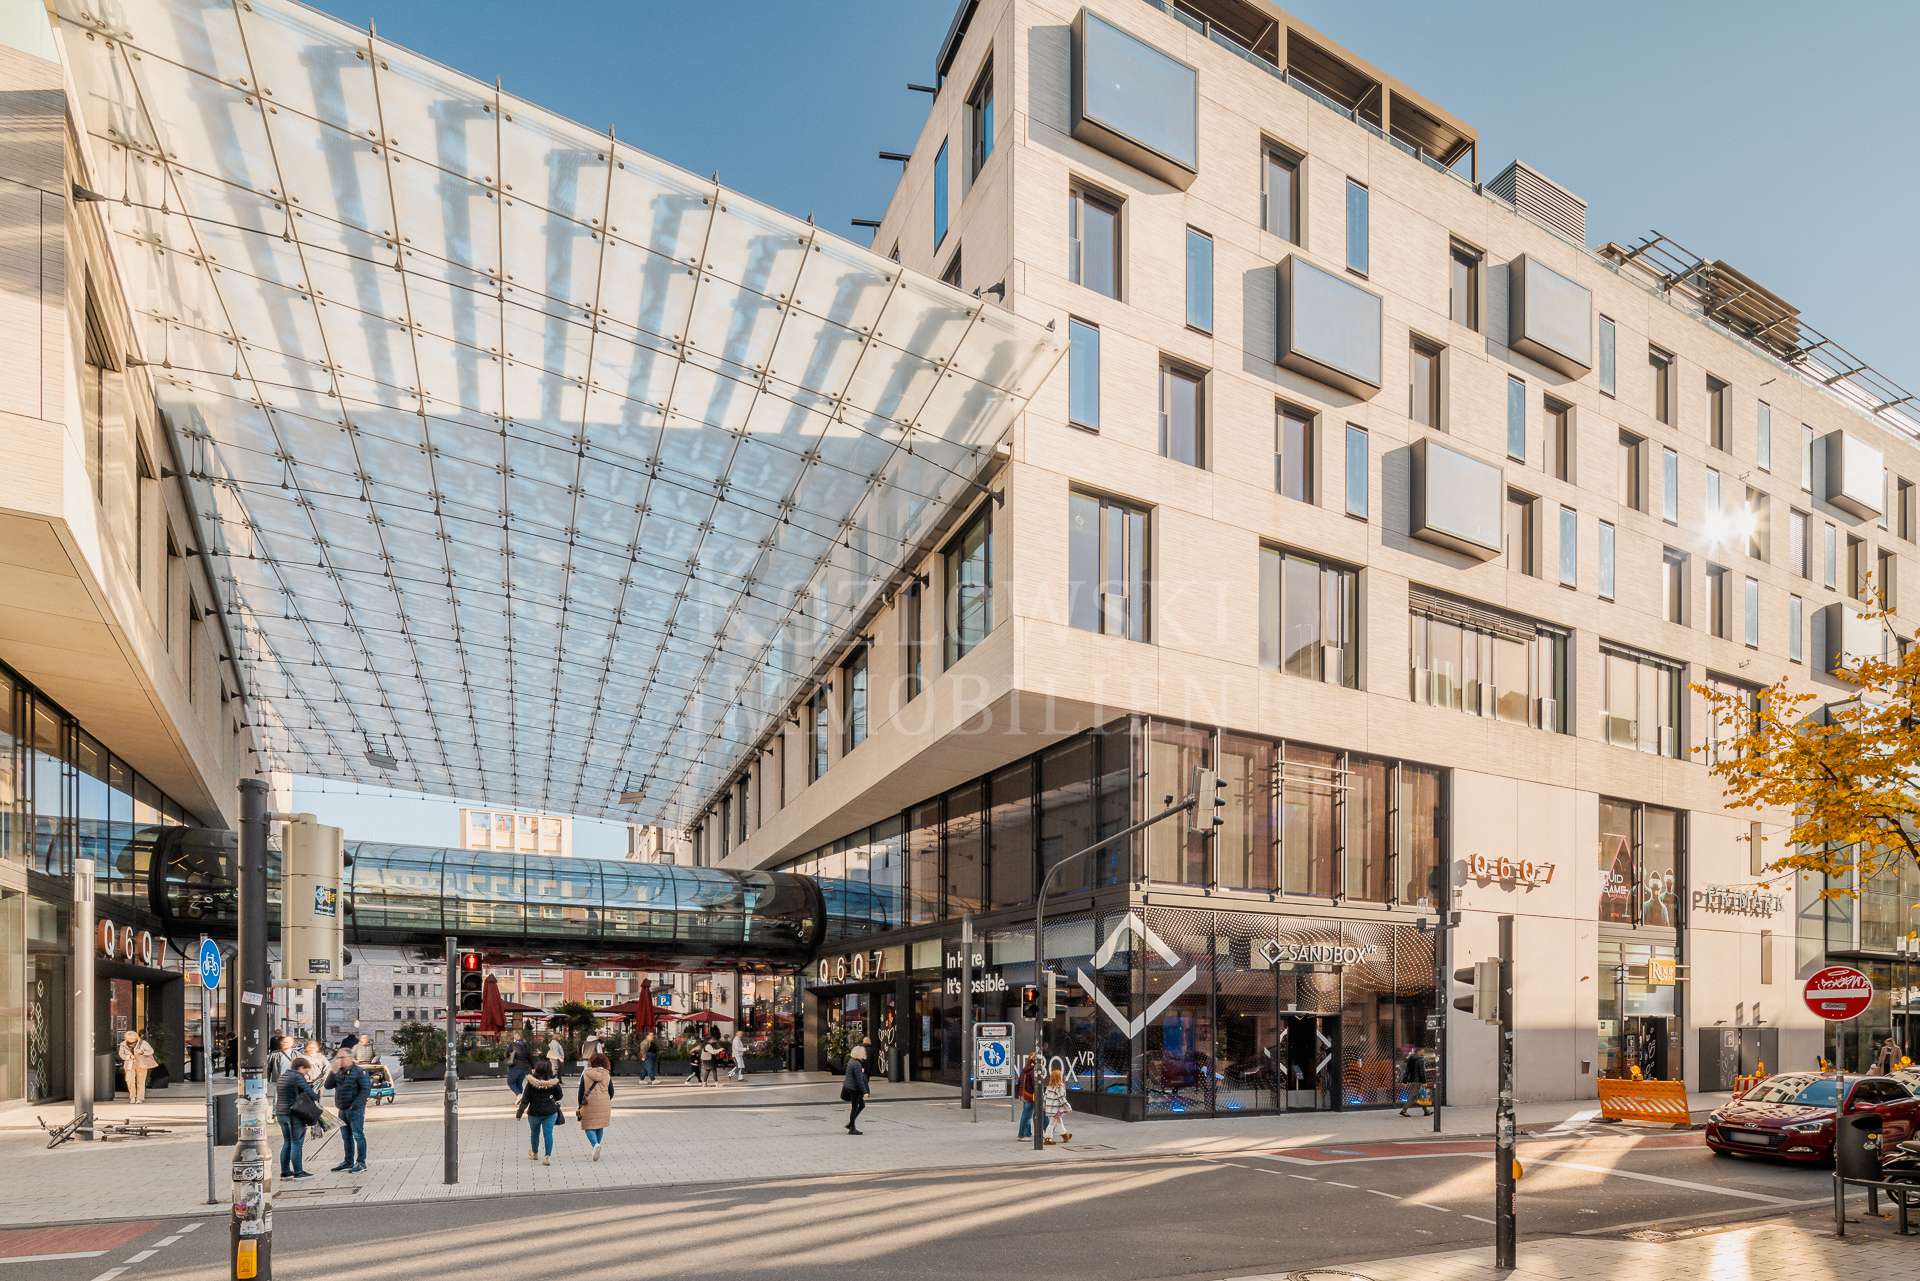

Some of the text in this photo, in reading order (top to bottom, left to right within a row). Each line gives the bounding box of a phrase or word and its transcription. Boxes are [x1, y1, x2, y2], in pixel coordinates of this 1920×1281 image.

[946, 952, 956, 969] In
[1287, 943, 1366, 964] SANDBOX
[946, 972, 1009, 995] It's ossible.
